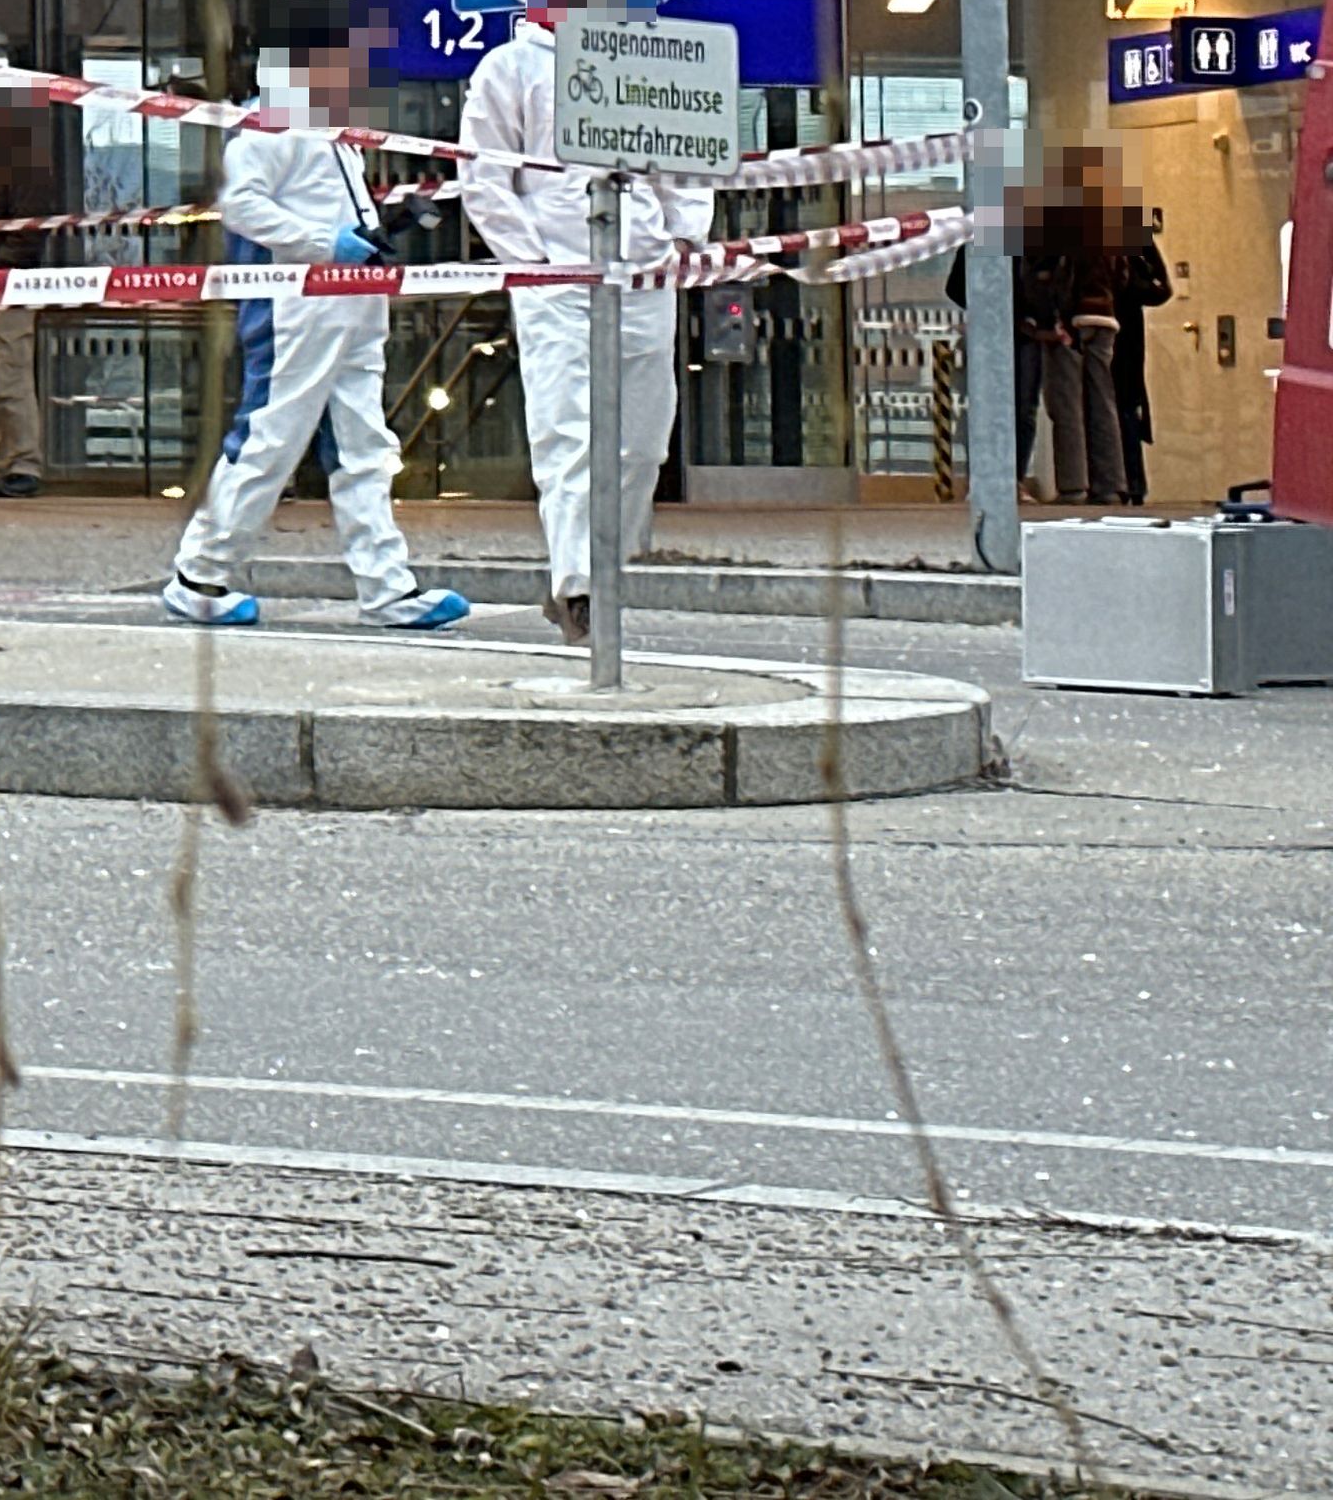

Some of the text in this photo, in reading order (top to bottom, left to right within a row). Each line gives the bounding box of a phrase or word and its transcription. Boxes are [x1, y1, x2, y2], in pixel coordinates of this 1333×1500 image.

[580, 26, 706, 64] ausgenommen
[615, 75, 723, 115] Linienbusse
[563, 118, 730, 167] u. Einsatzfahrzeuge
[25, 277, 98, 293] POLIZEI
[124, 275, 197, 292] POLIZEI
[325, 267, 397, 284] POLIZEI
